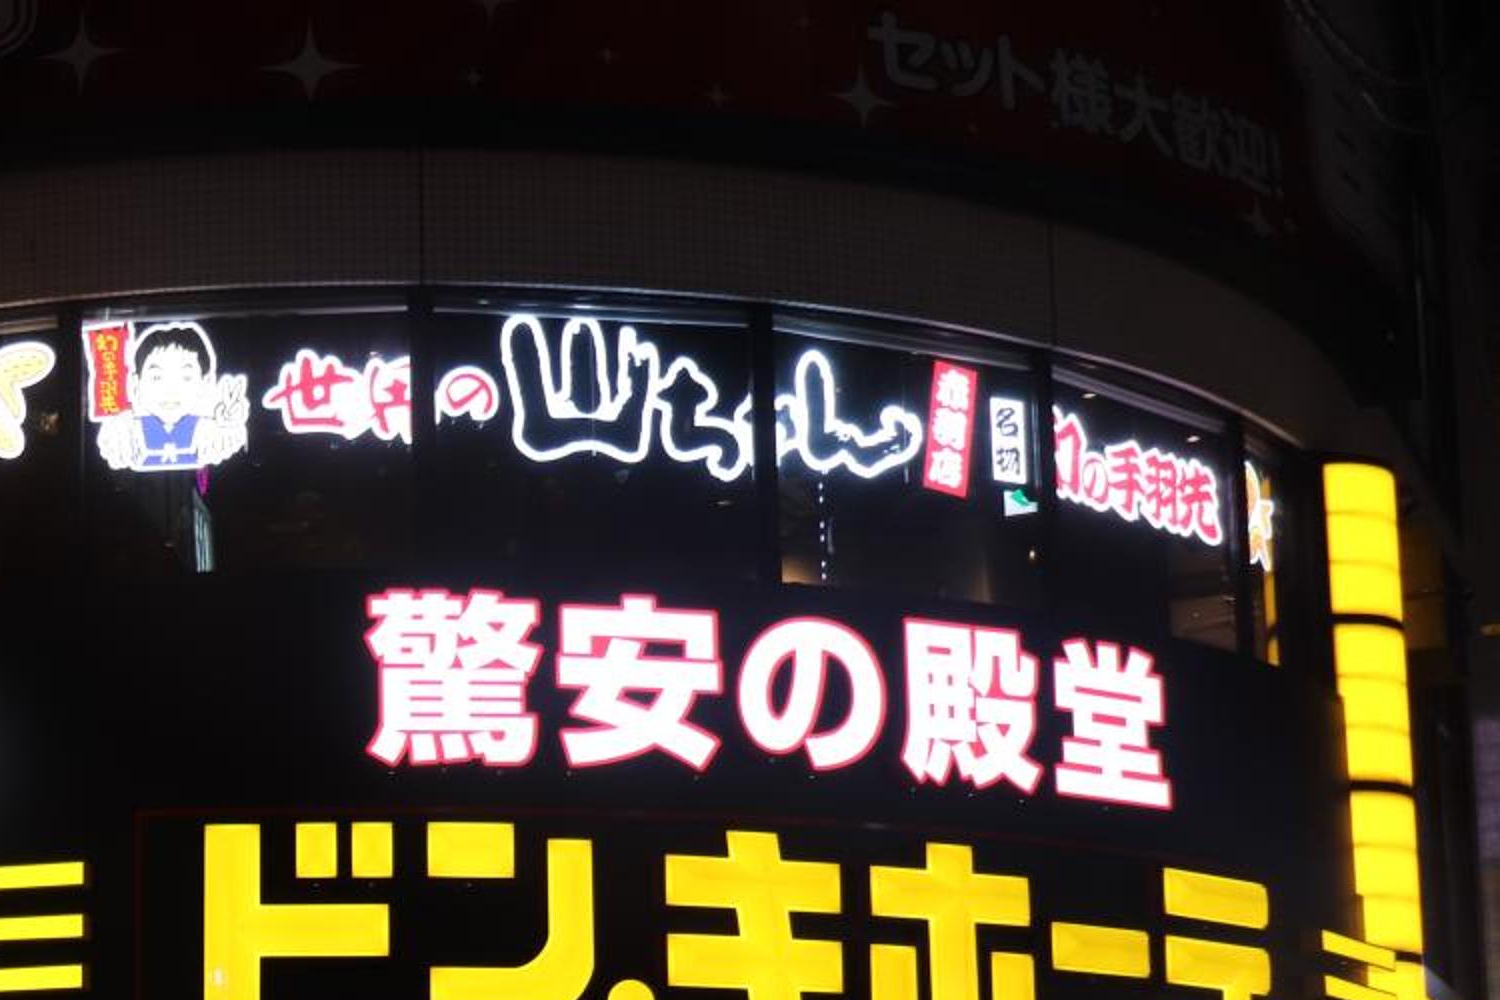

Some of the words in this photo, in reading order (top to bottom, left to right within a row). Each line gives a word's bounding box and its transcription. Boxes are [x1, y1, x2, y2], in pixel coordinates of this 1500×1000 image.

[365, 589, 1173, 811] 驚安の殿堂
